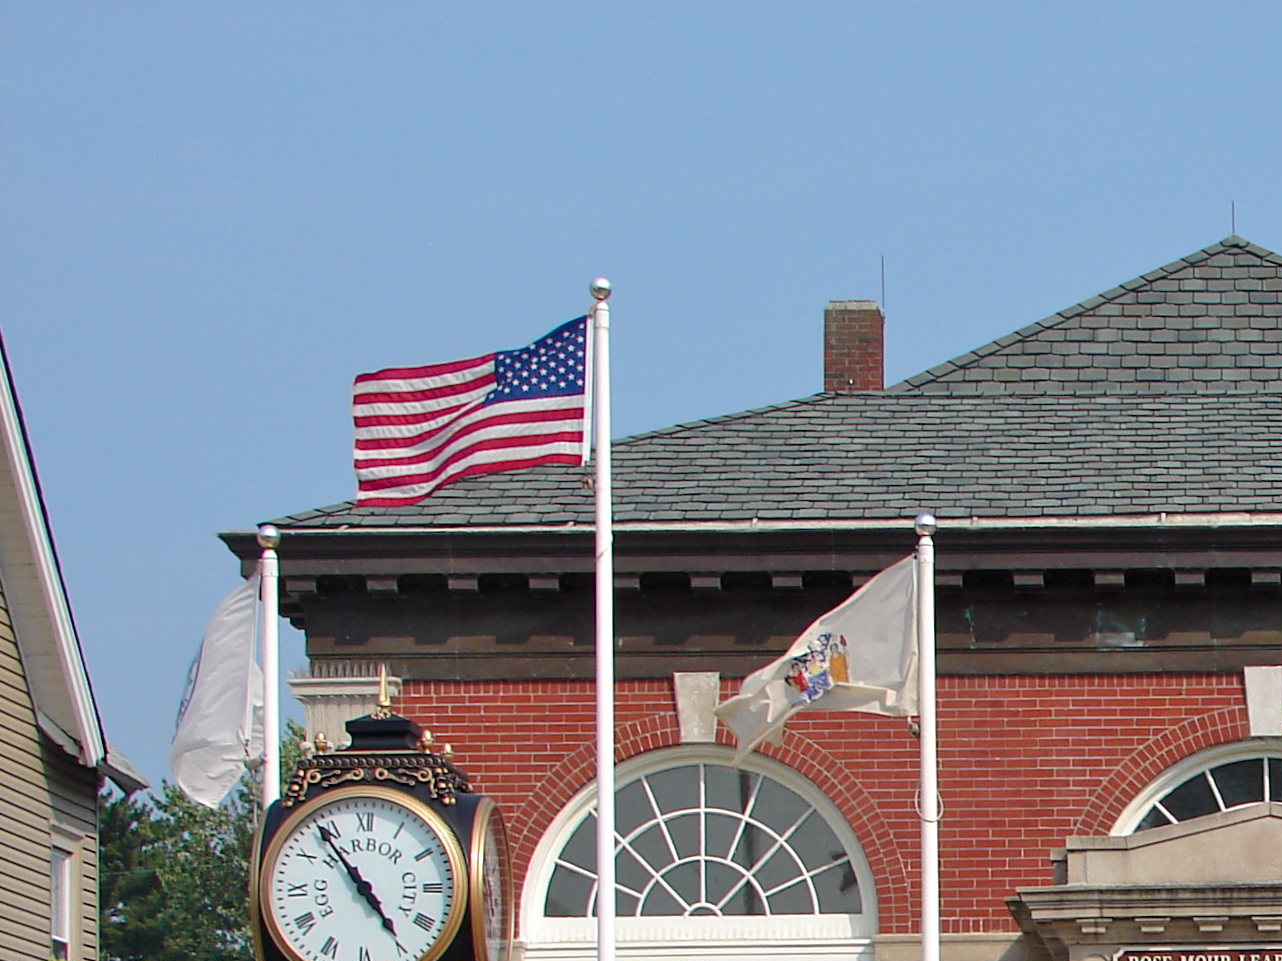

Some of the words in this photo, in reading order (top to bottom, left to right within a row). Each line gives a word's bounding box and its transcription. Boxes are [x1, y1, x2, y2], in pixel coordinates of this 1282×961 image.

[356, 812, 375, 832] XII
[323, 837, 402, 869] HARBOR
[315, 879, 334, 918] EGG
[398, 871, 417, 917] CITY
